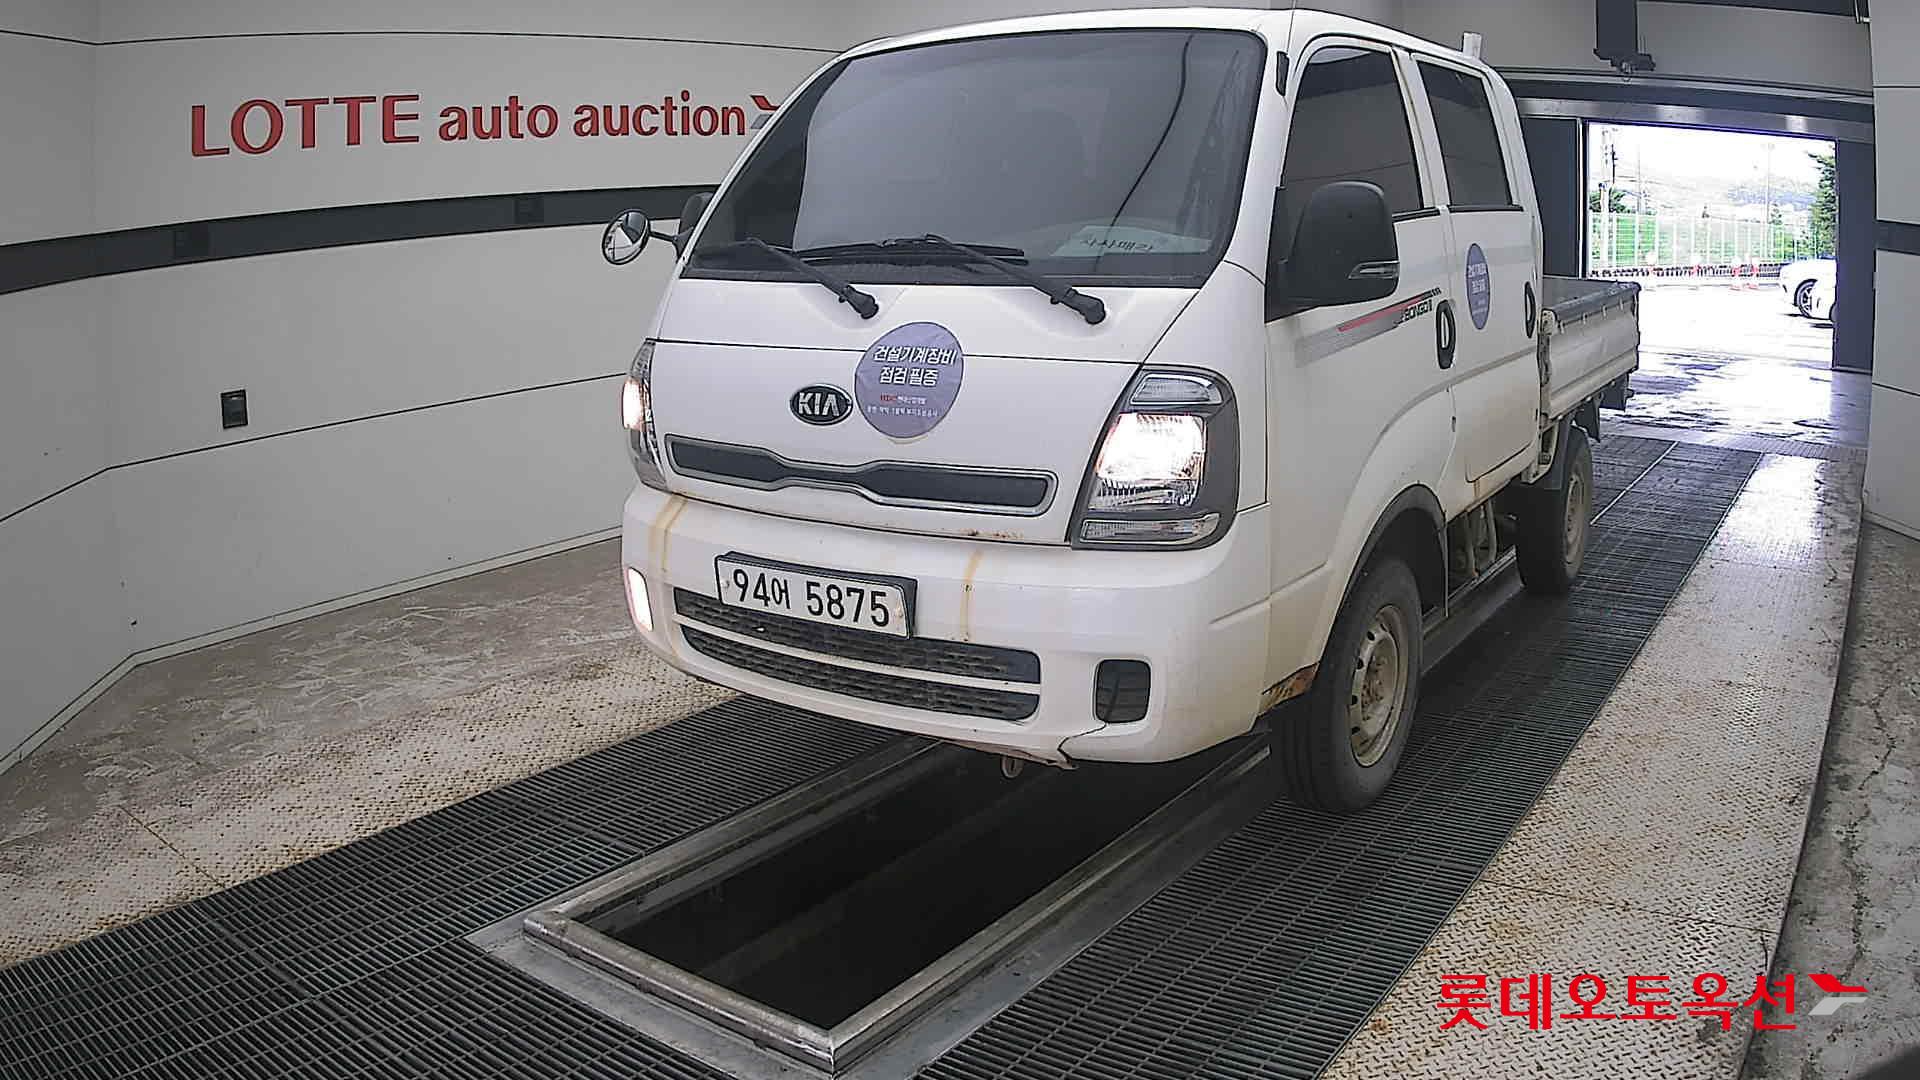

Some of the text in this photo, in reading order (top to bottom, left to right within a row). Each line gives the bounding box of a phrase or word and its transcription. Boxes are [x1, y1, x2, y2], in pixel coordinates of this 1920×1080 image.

[191, 90, 747, 156] LOTTE auto auction
[873, 345, 957, 365] 건설기계장비
[880, 366, 938, 386] 점검 필증
[798, 392, 840, 417] KIA
[733, 569, 889, 627] 94어 5875
